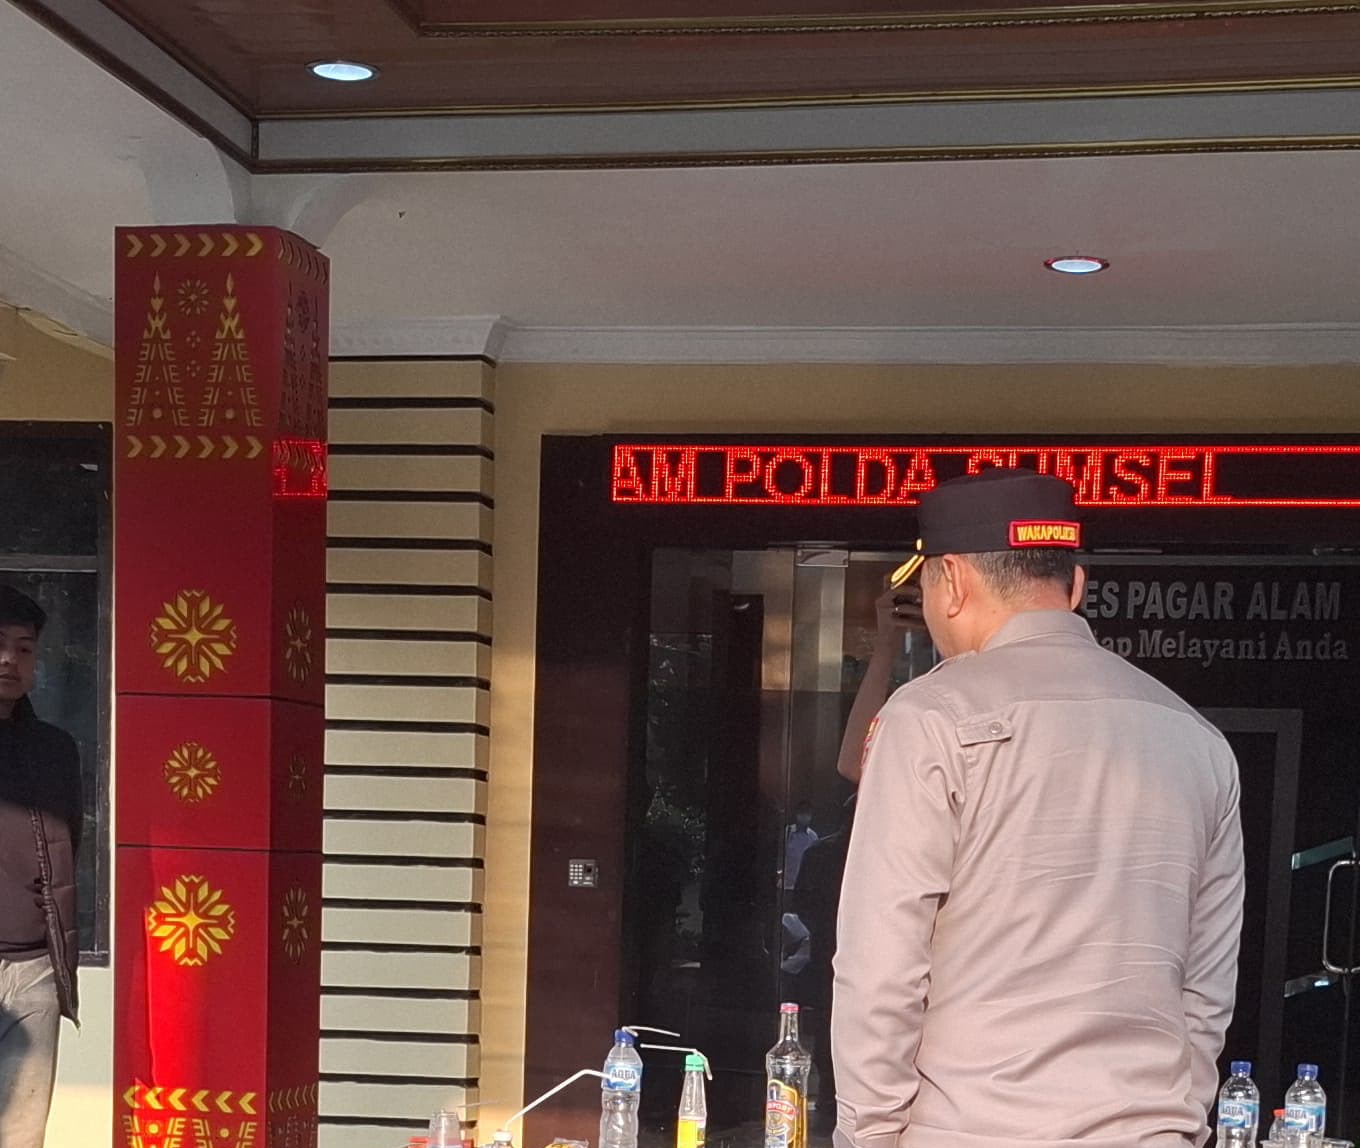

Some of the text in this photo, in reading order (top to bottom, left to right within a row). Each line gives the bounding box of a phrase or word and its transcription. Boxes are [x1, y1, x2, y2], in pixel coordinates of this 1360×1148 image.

[726, 448, 936, 502] POLDA
[1126, 581, 1234, 620] PAGAR
[1246, 581, 1340, 620] ALAM
[1136, 629, 1267, 667] Melayani
[1272, 631, 1349, 660] Anda
